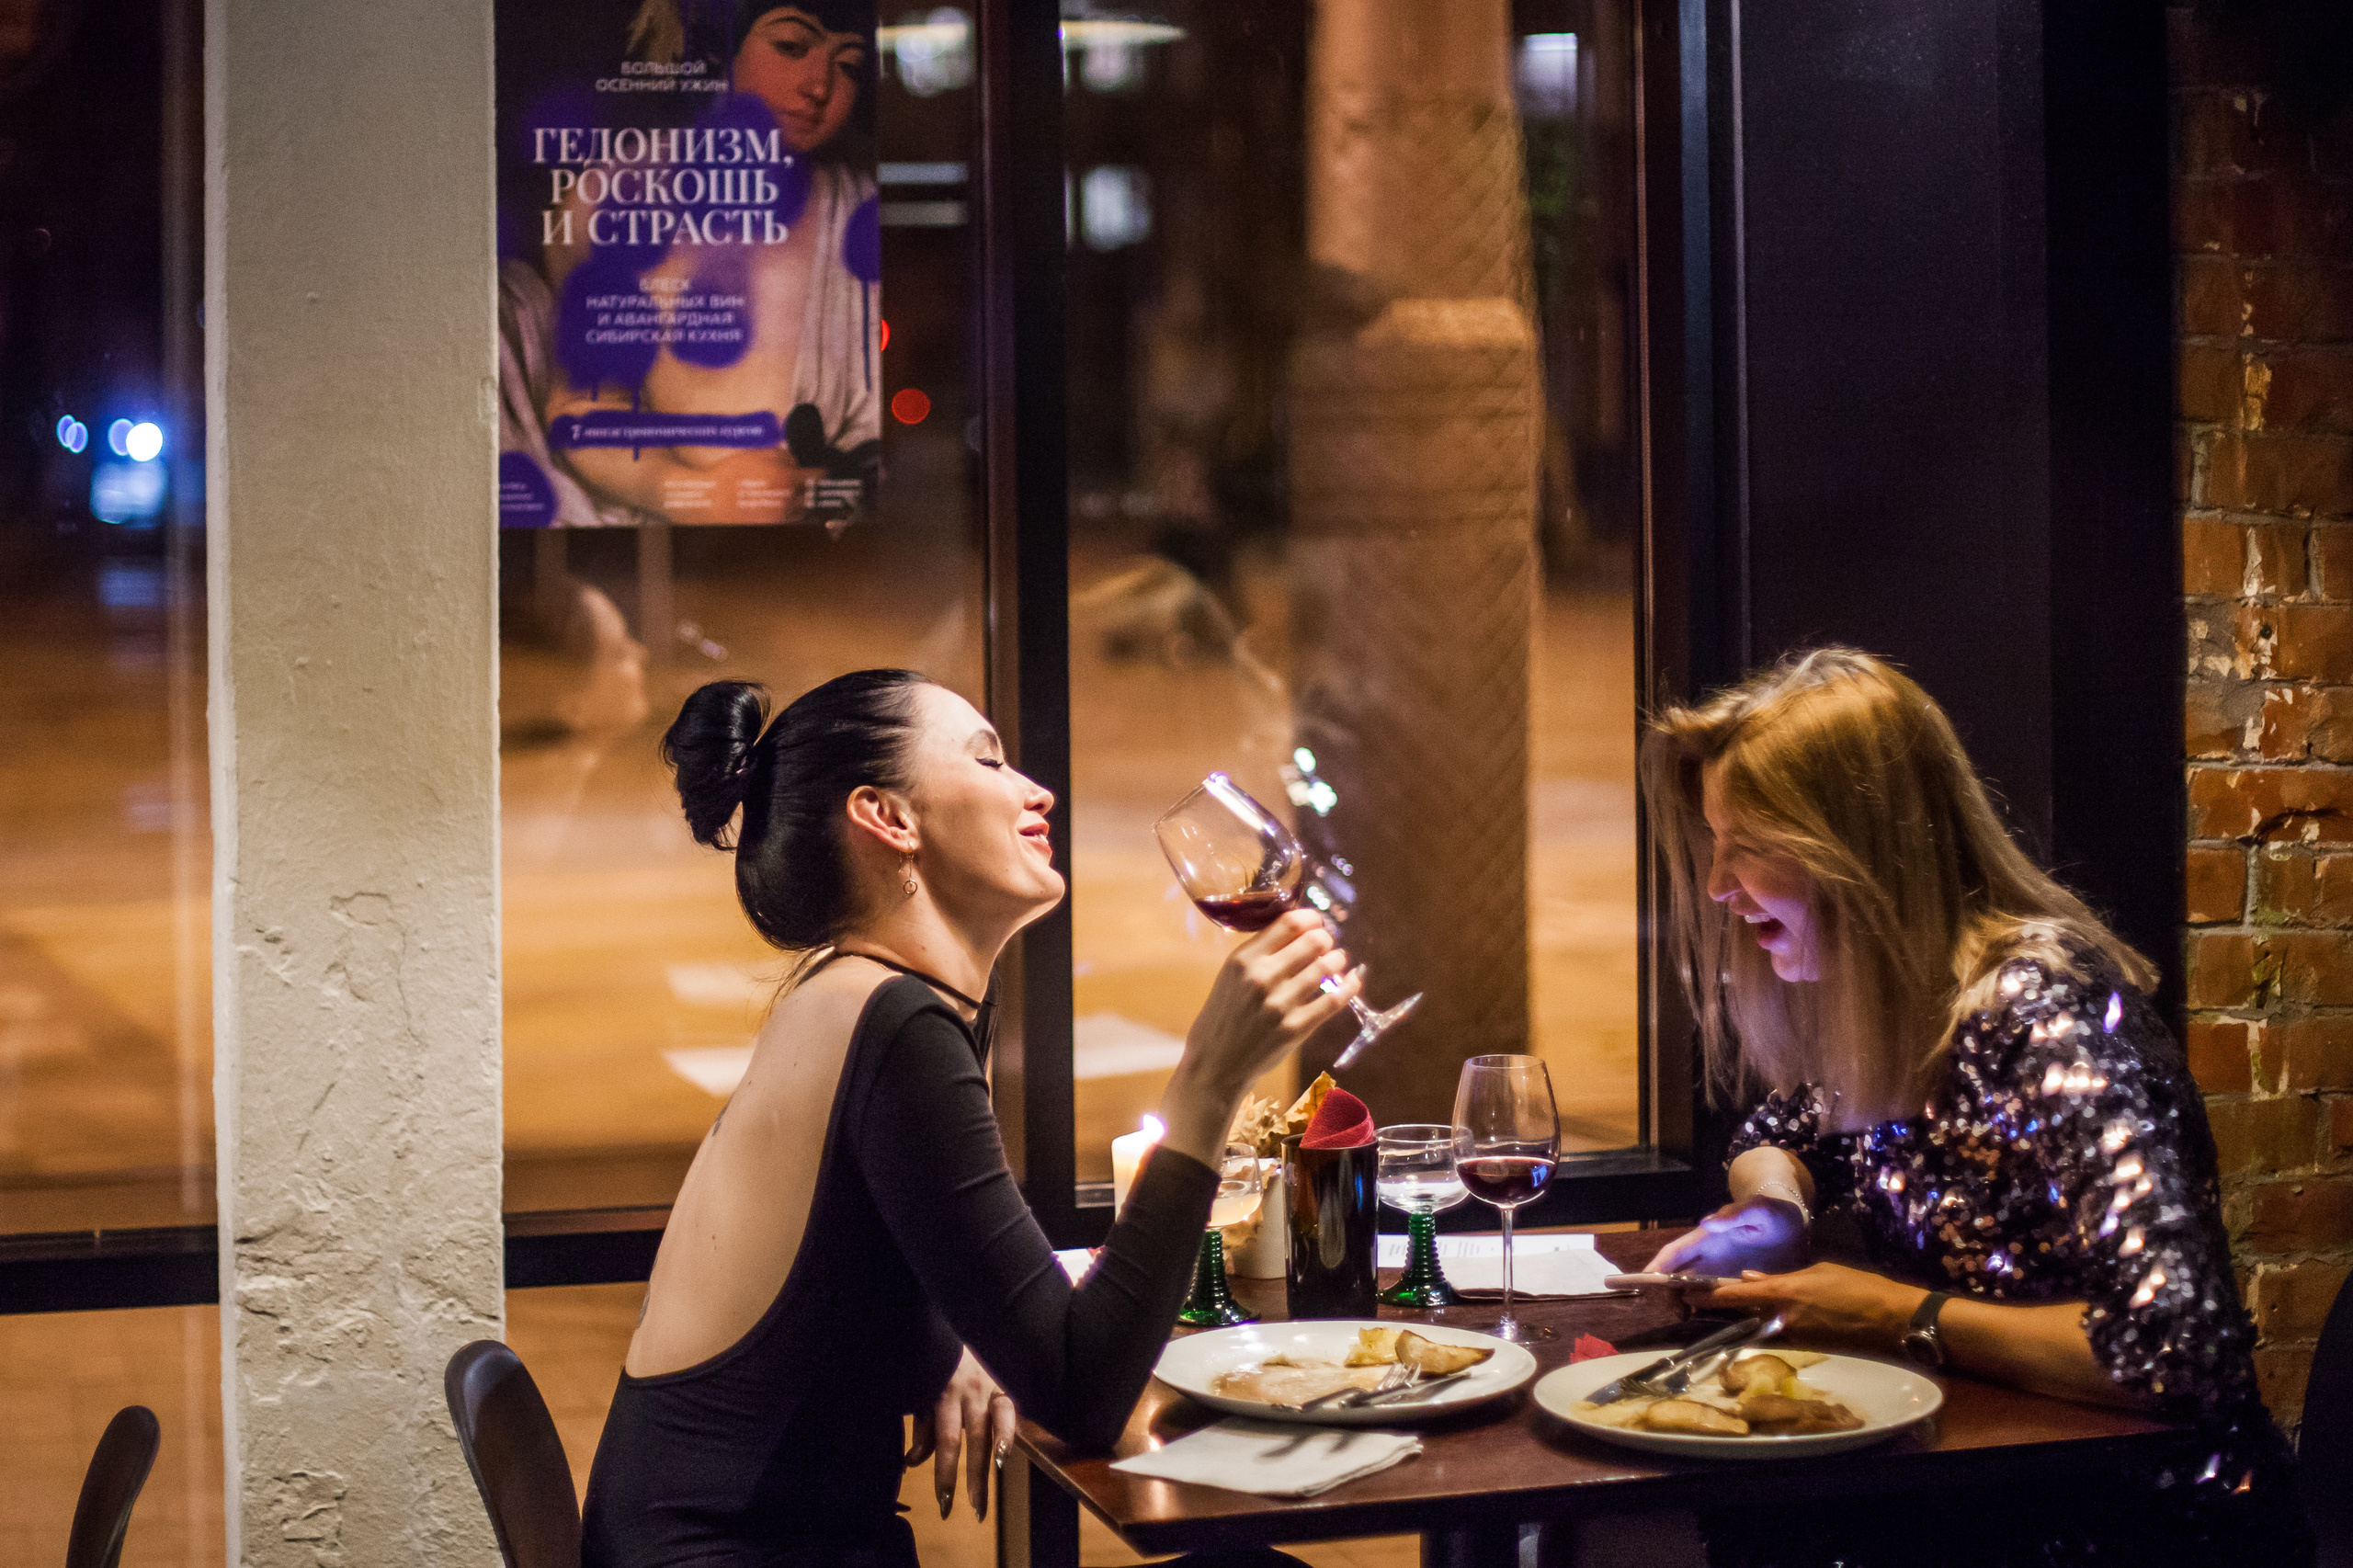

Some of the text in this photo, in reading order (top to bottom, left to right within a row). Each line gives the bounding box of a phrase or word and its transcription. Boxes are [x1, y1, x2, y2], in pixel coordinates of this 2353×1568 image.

[620, 60, 707, 75] БОЛЬШОЙ
[595, 77, 729, 92] ОСЕННИЙ УЖИН
[532, 127, 794, 169] ГЕДОНИЗМ,
[550, 168, 780, 205] РОСКОШЬ
[540, 209, 790, 246] И СТРАСТЬ
[585, 293, 745, 310] НАТУРАЛЬНЫХ ВИН
[597, 311, 733, 328] И АВАНГАРДНАЯ
[585, 328, 743, 345] СИБИРСКАЯ КУХНЯ
